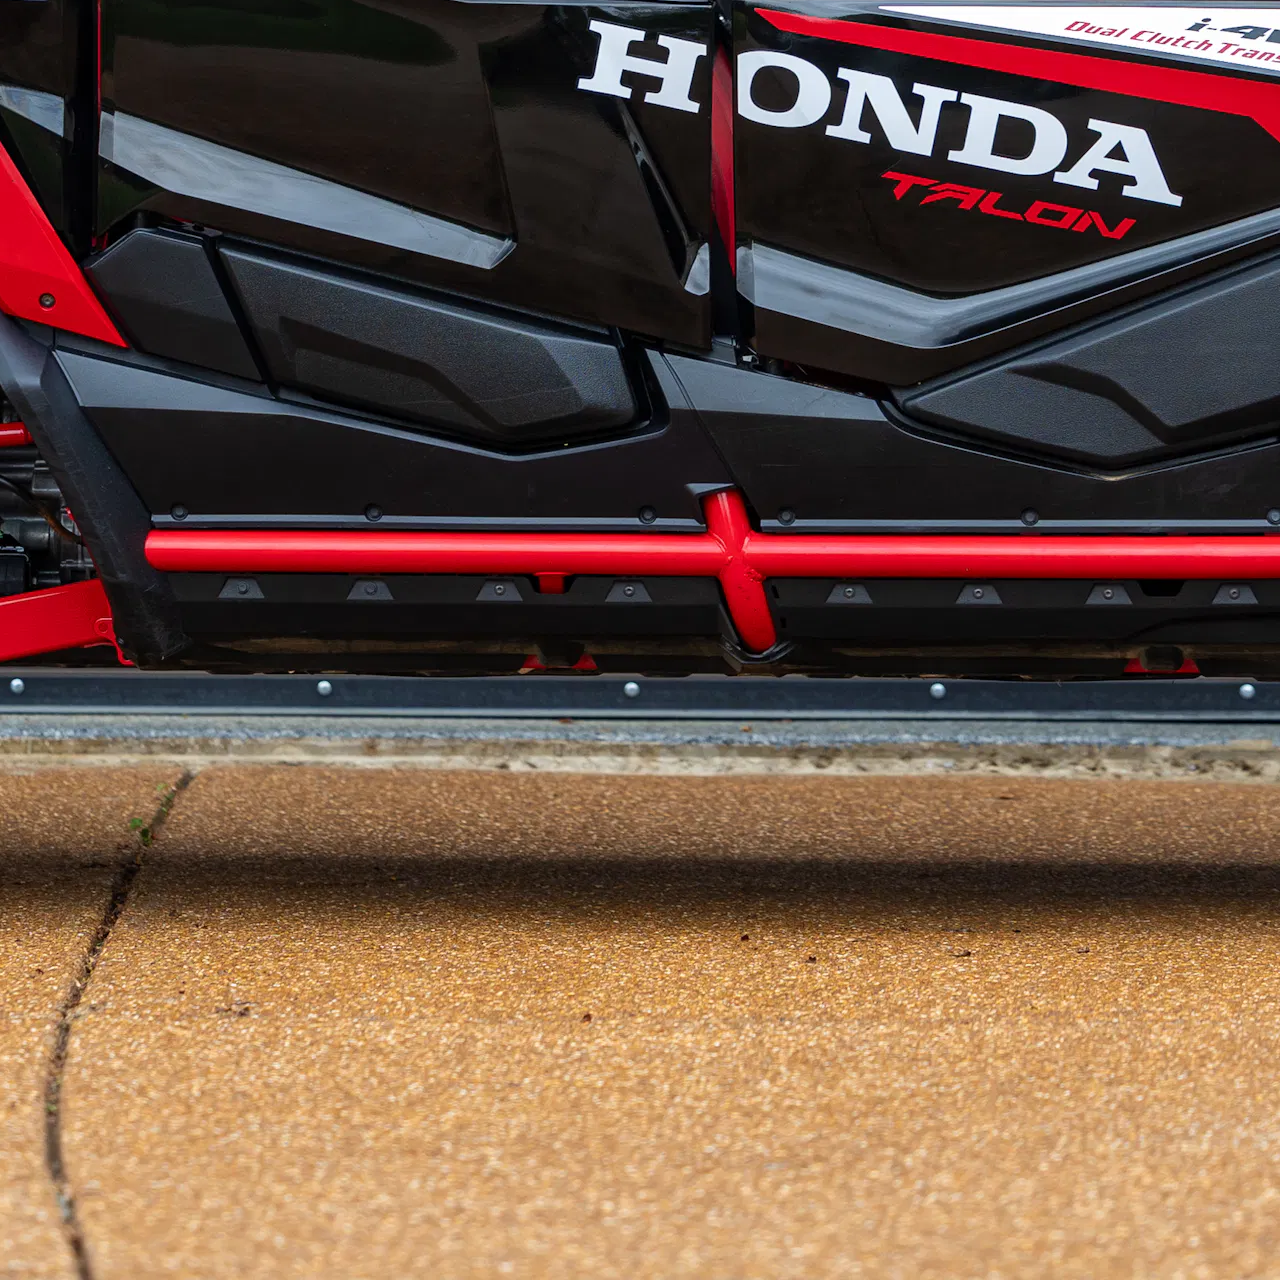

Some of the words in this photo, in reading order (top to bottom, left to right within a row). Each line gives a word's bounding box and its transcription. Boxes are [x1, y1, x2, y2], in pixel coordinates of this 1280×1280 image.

[1064, 20, 1129, 39] Dual
[1129, 30, 1214, 52] Clutch
[576, 18, 1184, 208] HONDA
[880, 170, 1138, 241] TALON
